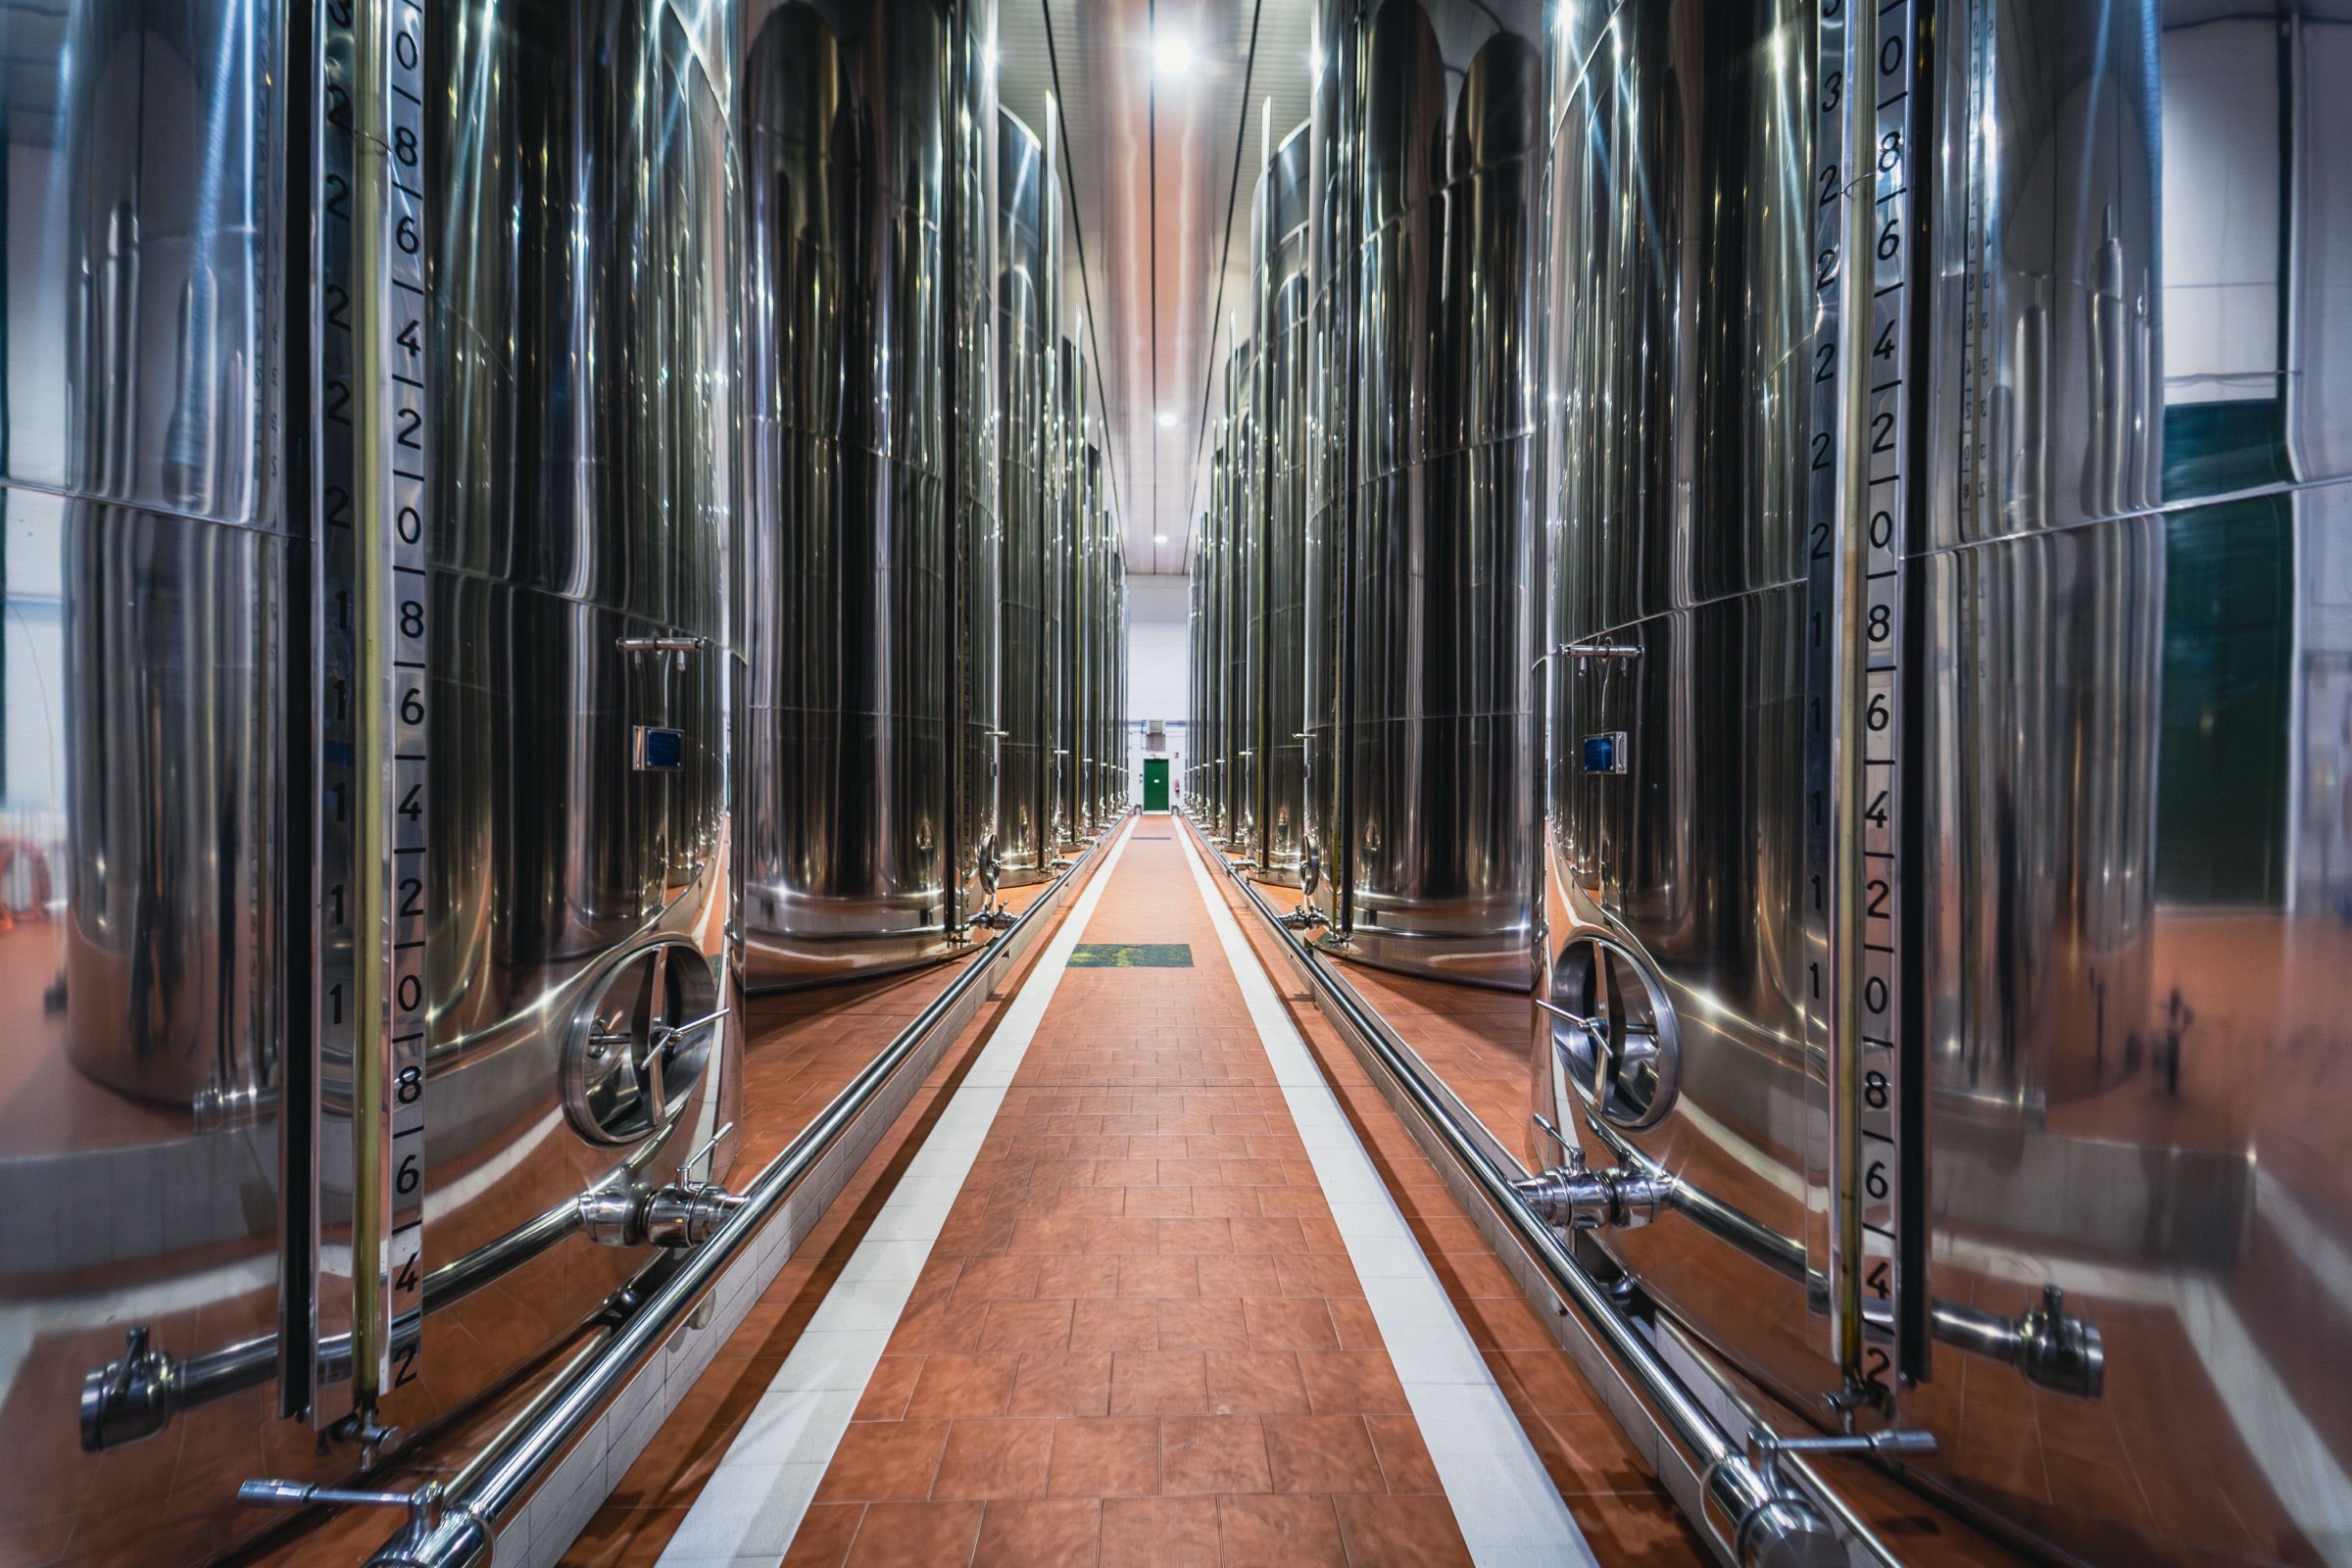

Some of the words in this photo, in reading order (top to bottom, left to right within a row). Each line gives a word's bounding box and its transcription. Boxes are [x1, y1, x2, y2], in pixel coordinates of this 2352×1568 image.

[395, 31, 417, 71] 0
[1822, 71, 1842, 113] 3
[1880, 35, 1903, 75] 0
[395, 126, 417, 168] 8
[1819, 165, 1838, 208] 2
[1879, 131, 1902, 172] 8
[326, 173, 350, 222] 2
[397, 216, 419, 255] 6
[1816, 249, 1837, 290] 2
[1877, 219, 1899, 261] 6
[326, 283, 351, 331] 2
[397, 319, 420, 358] 4
[1816, 343, 1836, 384] 2
[1873, 319, 1895, 360] 4
[326, 380, 351, 425] 2
[397, 408, 421, 450] 2
[1812, 431, 1832, 471] 2
[1871, 413, 1895, 454] 2
[325, 485, 350, 529] 2
[398, 507, 421, 544] 0
[1811, 521, 1830, 560] 2
[1870, 511, 1892, 549] 0
[400, 601, 424, 638] 8
[1867, 605, 1890, 642] 8
[400, 688, 424, 725] 6
[1866, 693, 1889, 731] 6
[332, 782, 345, 822] 1
[398, 784, 422, 821] 4
[1865, 791, 1889, 828] 4
[330, 884, 343, 925] 1
[398, 877, 424, 917] 2
[1811, 874, 1821, 910] 1
[1867, 879, 1890, 919] 2
[329, 984, 342, 1025] 1
[398, 974, 421, 1012] 0
[1809, 962, 1820, 999] 1
[1865, 976, 1887, 1014] 0
[398, 1066, 421, 1104] 8
[1865, 1070, 1887, 1109] 8
[396, 1154, 419, 1195] 6
[1865, 1160, 1888, 1199] 6
[395, 1250, 418, 1293] 4
[1866, 1261, 1890, 1300] 4
[394, 1345, 417, 1389] 2
[1867, 1347, 1890, 1392] 2
